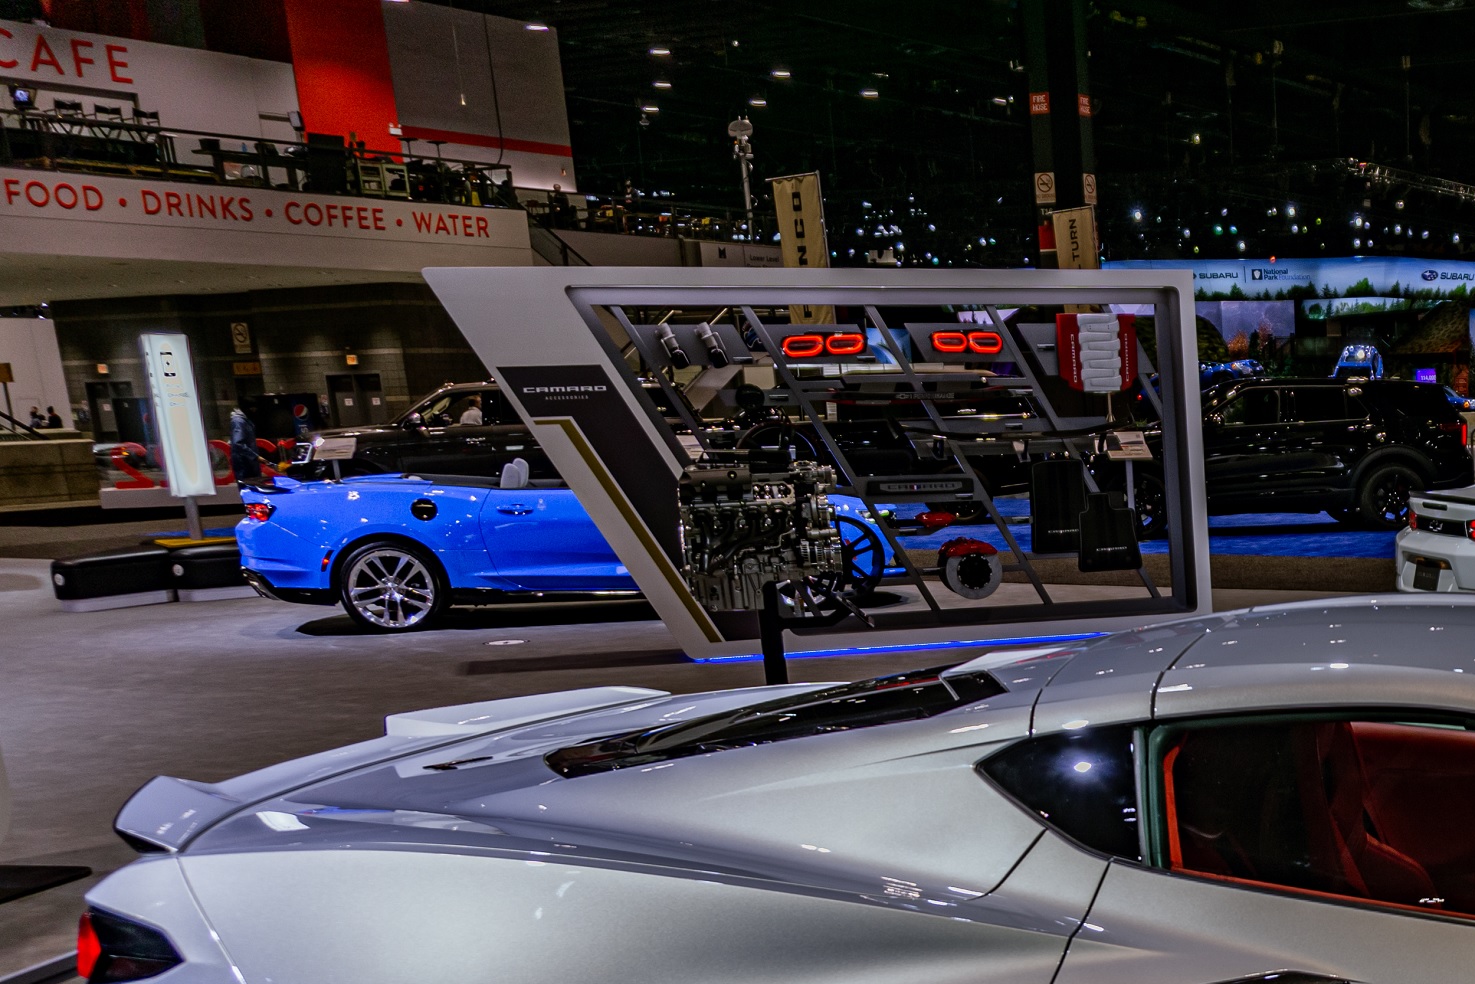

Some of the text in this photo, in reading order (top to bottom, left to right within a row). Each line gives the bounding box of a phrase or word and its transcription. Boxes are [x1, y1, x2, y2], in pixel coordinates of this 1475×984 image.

[1032, 94, 1046, 104] FIRE
[1032, 103, 1048, 111] HOSE
[4, 178, 490, 239] FOOD DRINKS COFFEE WATER
[1069, 219, 1080, 262] TURN
[1440, 271, 1475, 281] SUBARU
[1070, 333, 1078, 383] CAMARO
[523, 385, 607, 393] CAMARO
